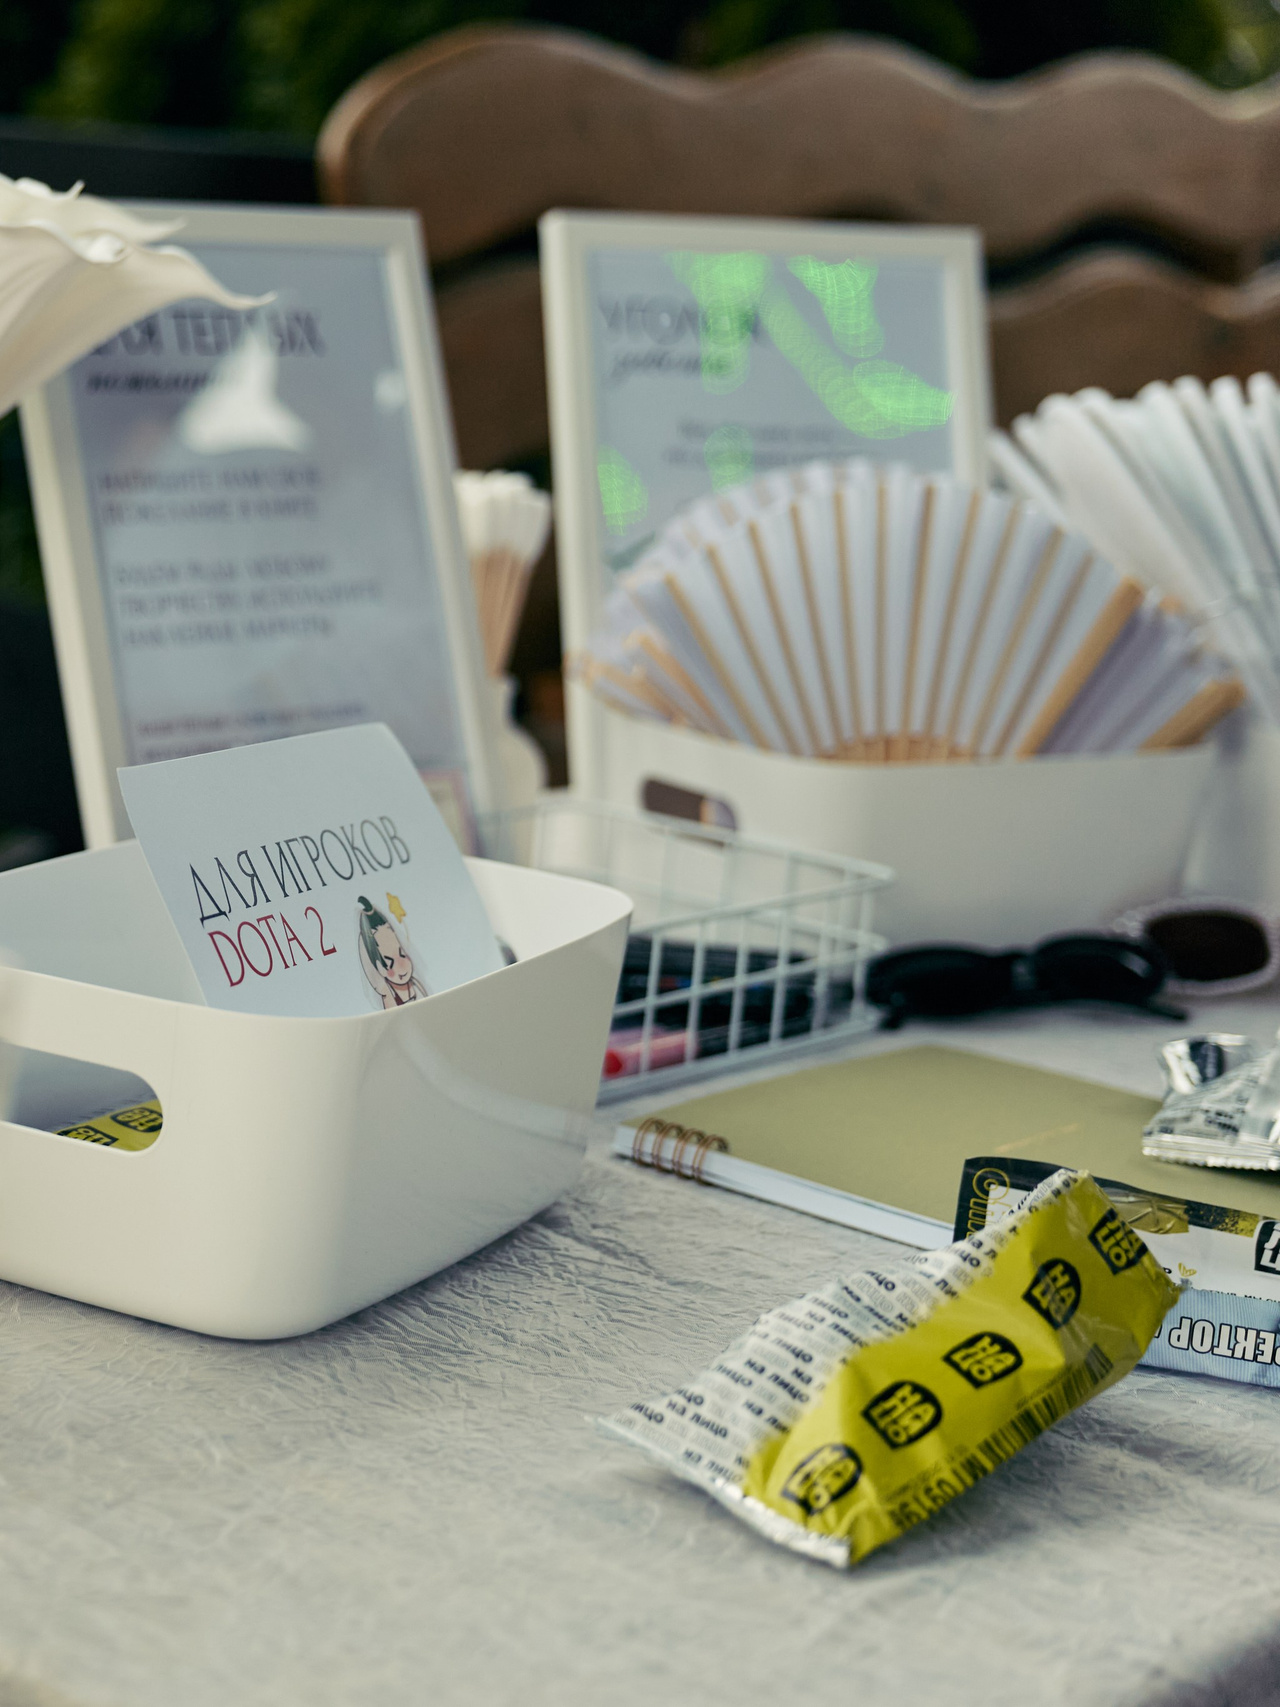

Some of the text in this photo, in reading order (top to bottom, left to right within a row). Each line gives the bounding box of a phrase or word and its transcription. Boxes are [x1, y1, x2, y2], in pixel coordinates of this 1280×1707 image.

[189, 815, 411, 928] ДЛЯ ИГРОКОВ
[207, 906, 337, 987] DOTA 2
[1168, 1315, 1280, 1367] ЕКТОР
[744, 1358, 766, 1375] на
[768, 1372, 811, 1403] лицо
[666, 1399, 728, 1438] на лицо
